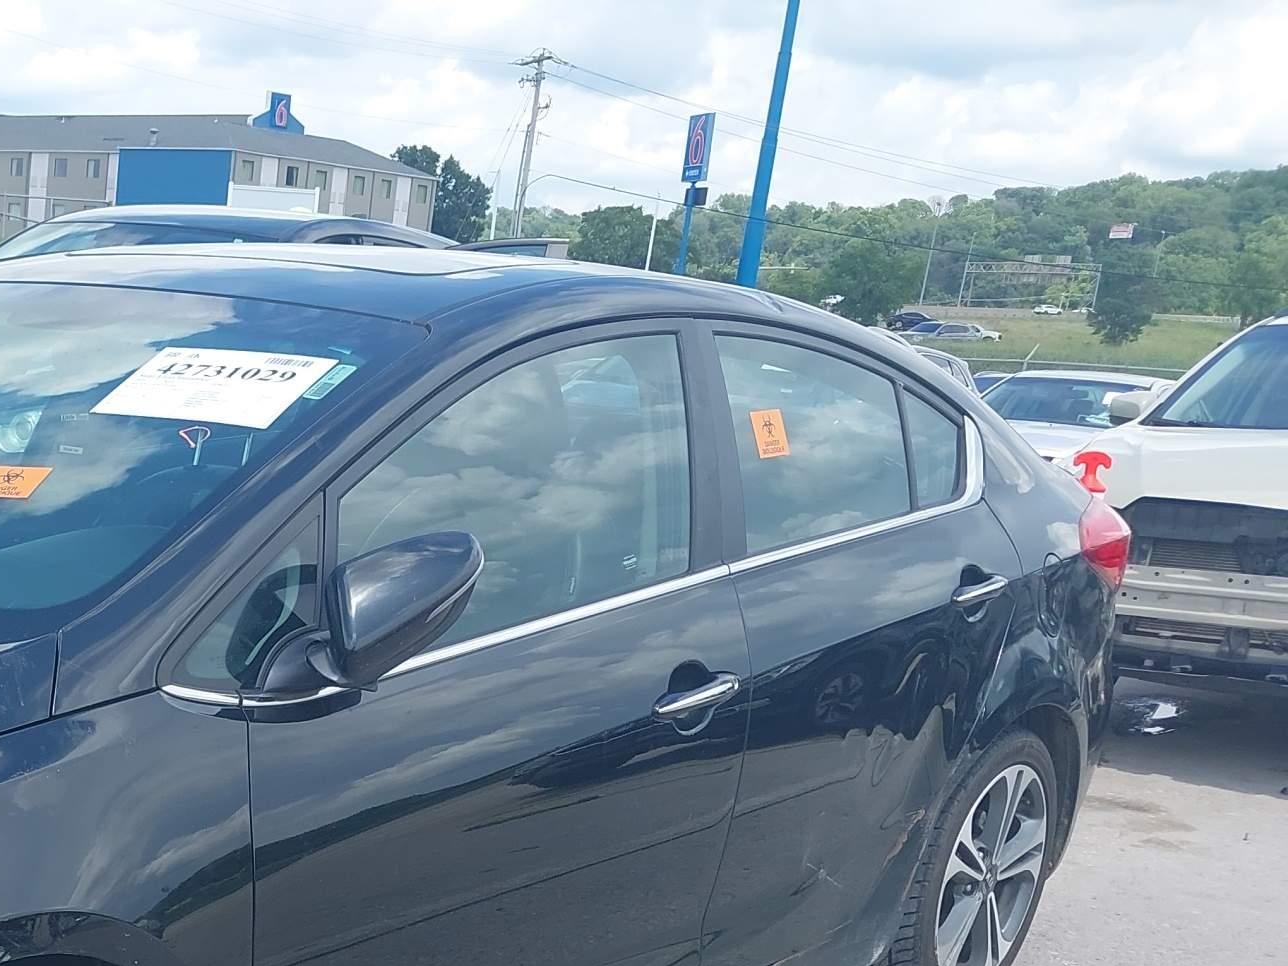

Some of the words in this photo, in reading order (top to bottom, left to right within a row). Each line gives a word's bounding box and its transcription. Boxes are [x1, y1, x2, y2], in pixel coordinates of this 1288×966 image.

[275, 99, 288, 126] 6
[689, 115, 705, 166] 6
[157, 362, 297, 382] 42731029
